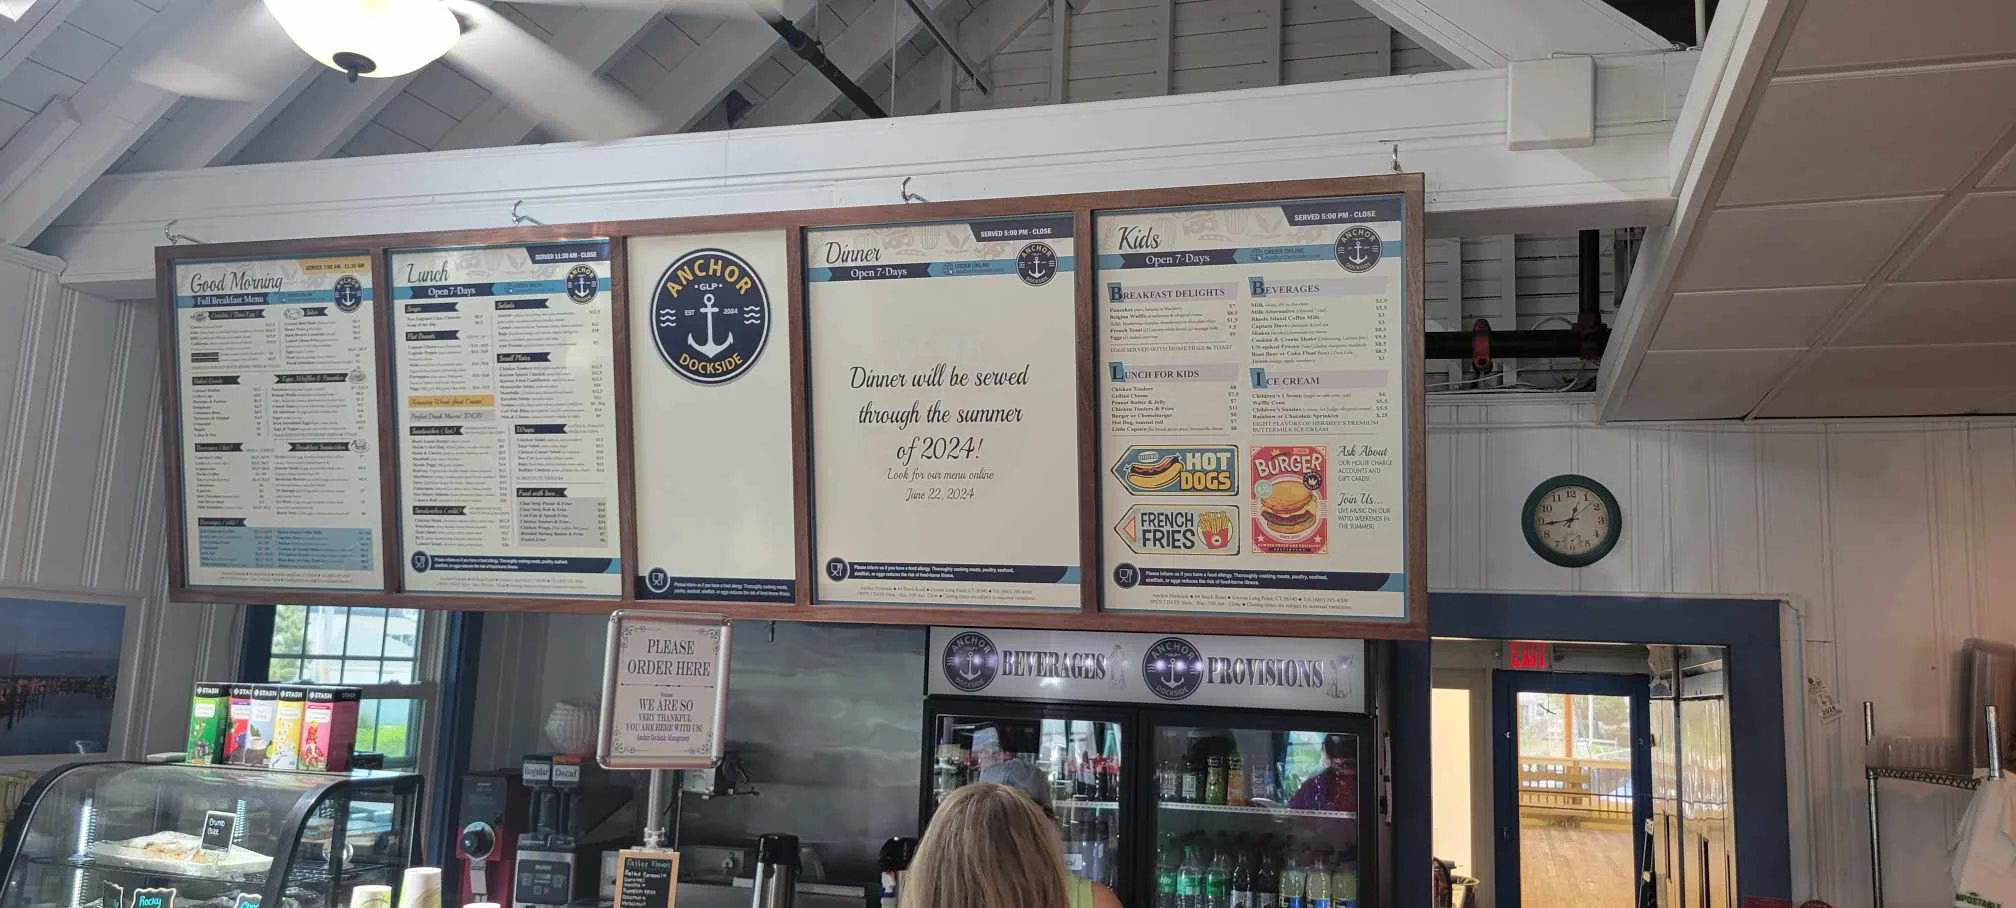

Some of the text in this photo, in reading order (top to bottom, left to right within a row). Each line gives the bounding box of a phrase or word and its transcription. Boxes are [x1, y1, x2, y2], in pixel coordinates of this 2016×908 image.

[1118, 226, 1161, 250] Kids
[1341, 229, 1376, 243] ANCHOR
[824, 241, 882, 265] Dinner
[1146, 254, 1210, 267] Open 7-Days
[407, 261, 448, 283] Lunch
[666, 258, 752, 298] ANCHOR
[851, 267, 908, 279] Open 7-Days
[191, 271, 283, 294] Good Morning
[1252, 281, 1320, 296] BEVERAGES
[428, 287, 476, 297] Open 7-Days
[1110, 286, 1225, 301] BREAKFAST DELIGHTS
[198, 295, 265, 305] Full Breakfast Menu
[680, 352, 743, 374] DOCKSIDE
[850, 363, 1030, 389] Dinner will be served
[1112, 365, 1200, 380] LUNCH FOR KIDS
[1256, 371, 1320, 386] ICE CREAM
[858, 400, 1023, 430] through the summer
[897, 436, 984, 466] of 2024!
[1337, 445, 1388, 457] Ask About
[1185, 452, 1231, 471] HOT
[1255, 453, 1322, 477] BURGER
[887, 468, 994, 483] Look for our menu online
[1180, 471, 1232, 491] DOGS
[905, 488, 975, 502] June 22, 2024
[1338, 493, 1356, 506] Join
[1552, 494, 1561, 502] 11
[1566, 490, 1577, 499] 12
[1542, 505, 1552, 513] 10
[1593, 503, 1600, 511] 2
[1140, 511, 1194, 528] FRENCH
[1538, 517, 1545, 525] 9
[1598, 516, 1604, 525] 3
[1142, 528, 1196, 550] FRIES
[1544, 530, 1551, 538] 8
[648, 639, 695, 655] PLEASE
[951, 635, 991, 653] ANCHOR
[1151, 641, 1195, 660] ANCHOR
[1510, 640, 1546, 669] EXIT
[628, 660, 712, 676] ORDER HERE
[1001, 650, 1106, 680] BEVERAGES
[1207, 656, 1324, 689] PROVISIONS
[640, 698, 694, 712] WE ARE SO
[638, 713, 692, 722] VERY THANKFUL
[626, 722, 640, 732] YOU
[655, 723, 674, 732] HERE
[674, 724, 691, 732] WITH
[138, 896, 162, 908] Rocky
